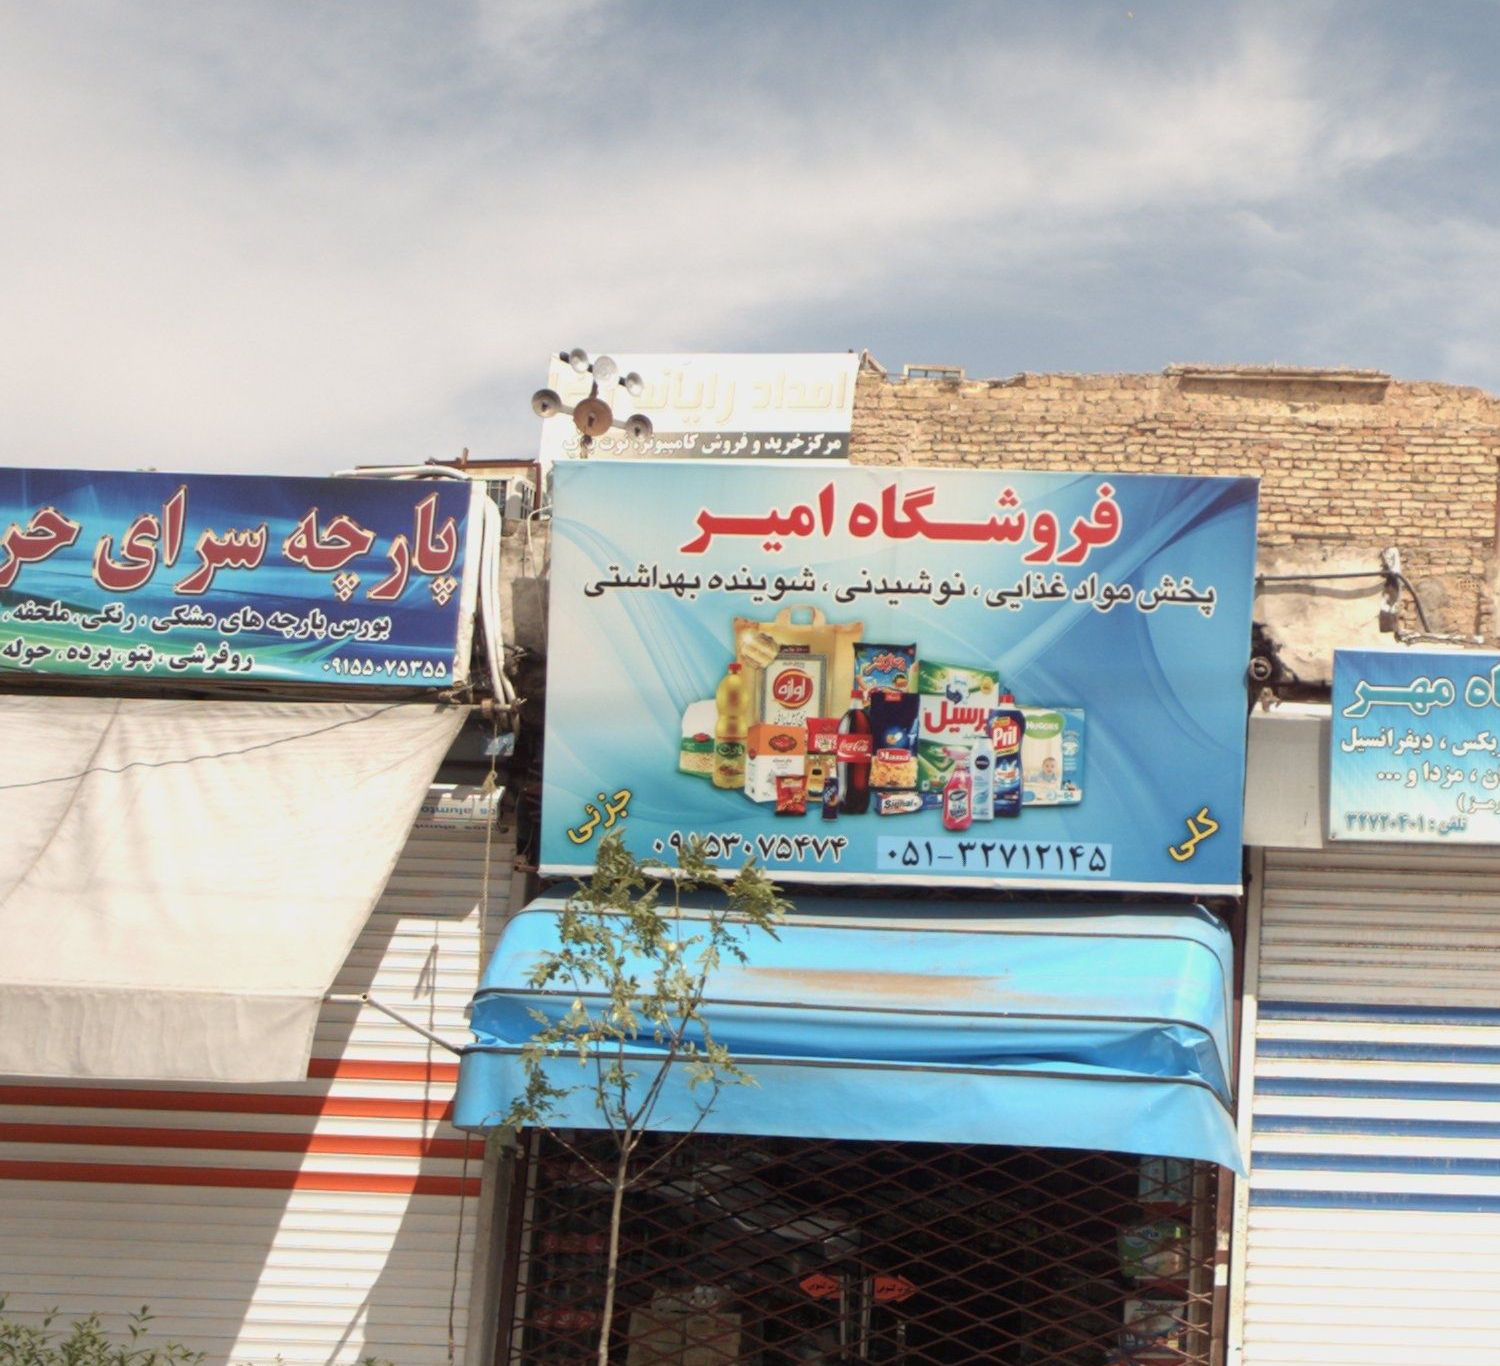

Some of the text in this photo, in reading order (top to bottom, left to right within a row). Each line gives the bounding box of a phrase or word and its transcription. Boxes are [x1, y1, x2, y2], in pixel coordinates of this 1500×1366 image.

[751, 370, 849, 413] امداد
[702, 433, 747, 455] فروش
[765, 433, 803, 456] خرید
[680, 481, 1121, 565] فروشگاه امیر
[283, 492, 459, 605] پارچه
[583, 563, 1216, 617] پخش مواد غذایی نوشیدنی شوینده بهداشتی
[12, 600, 71, 624] ملحفه
[151, 602, 217, 633] مشکی
[219, 605, 264, 634] های
[267, 607, 328, 640] پارچه
[329, 615, 392, 639] بورس
[1, 637, 255, 673] روفرشی پتو پرده حوله
[322, 657, 447, 678] ۰۹۱۵۵۰۷۵۳۵۵
[1343, 675, 1456, 719] مهر
[993, 724, 1018, 748] Pril
[1405, 767, 1418, 789] و
[1422, 759, 1465, 789] مزدا
[566, 788, 632, 845] جزئی
[652, 830, 848, 863] ۰۹۵۳۰۷۵۴۷۴
[1168, 806, 1221, 862] کلی
